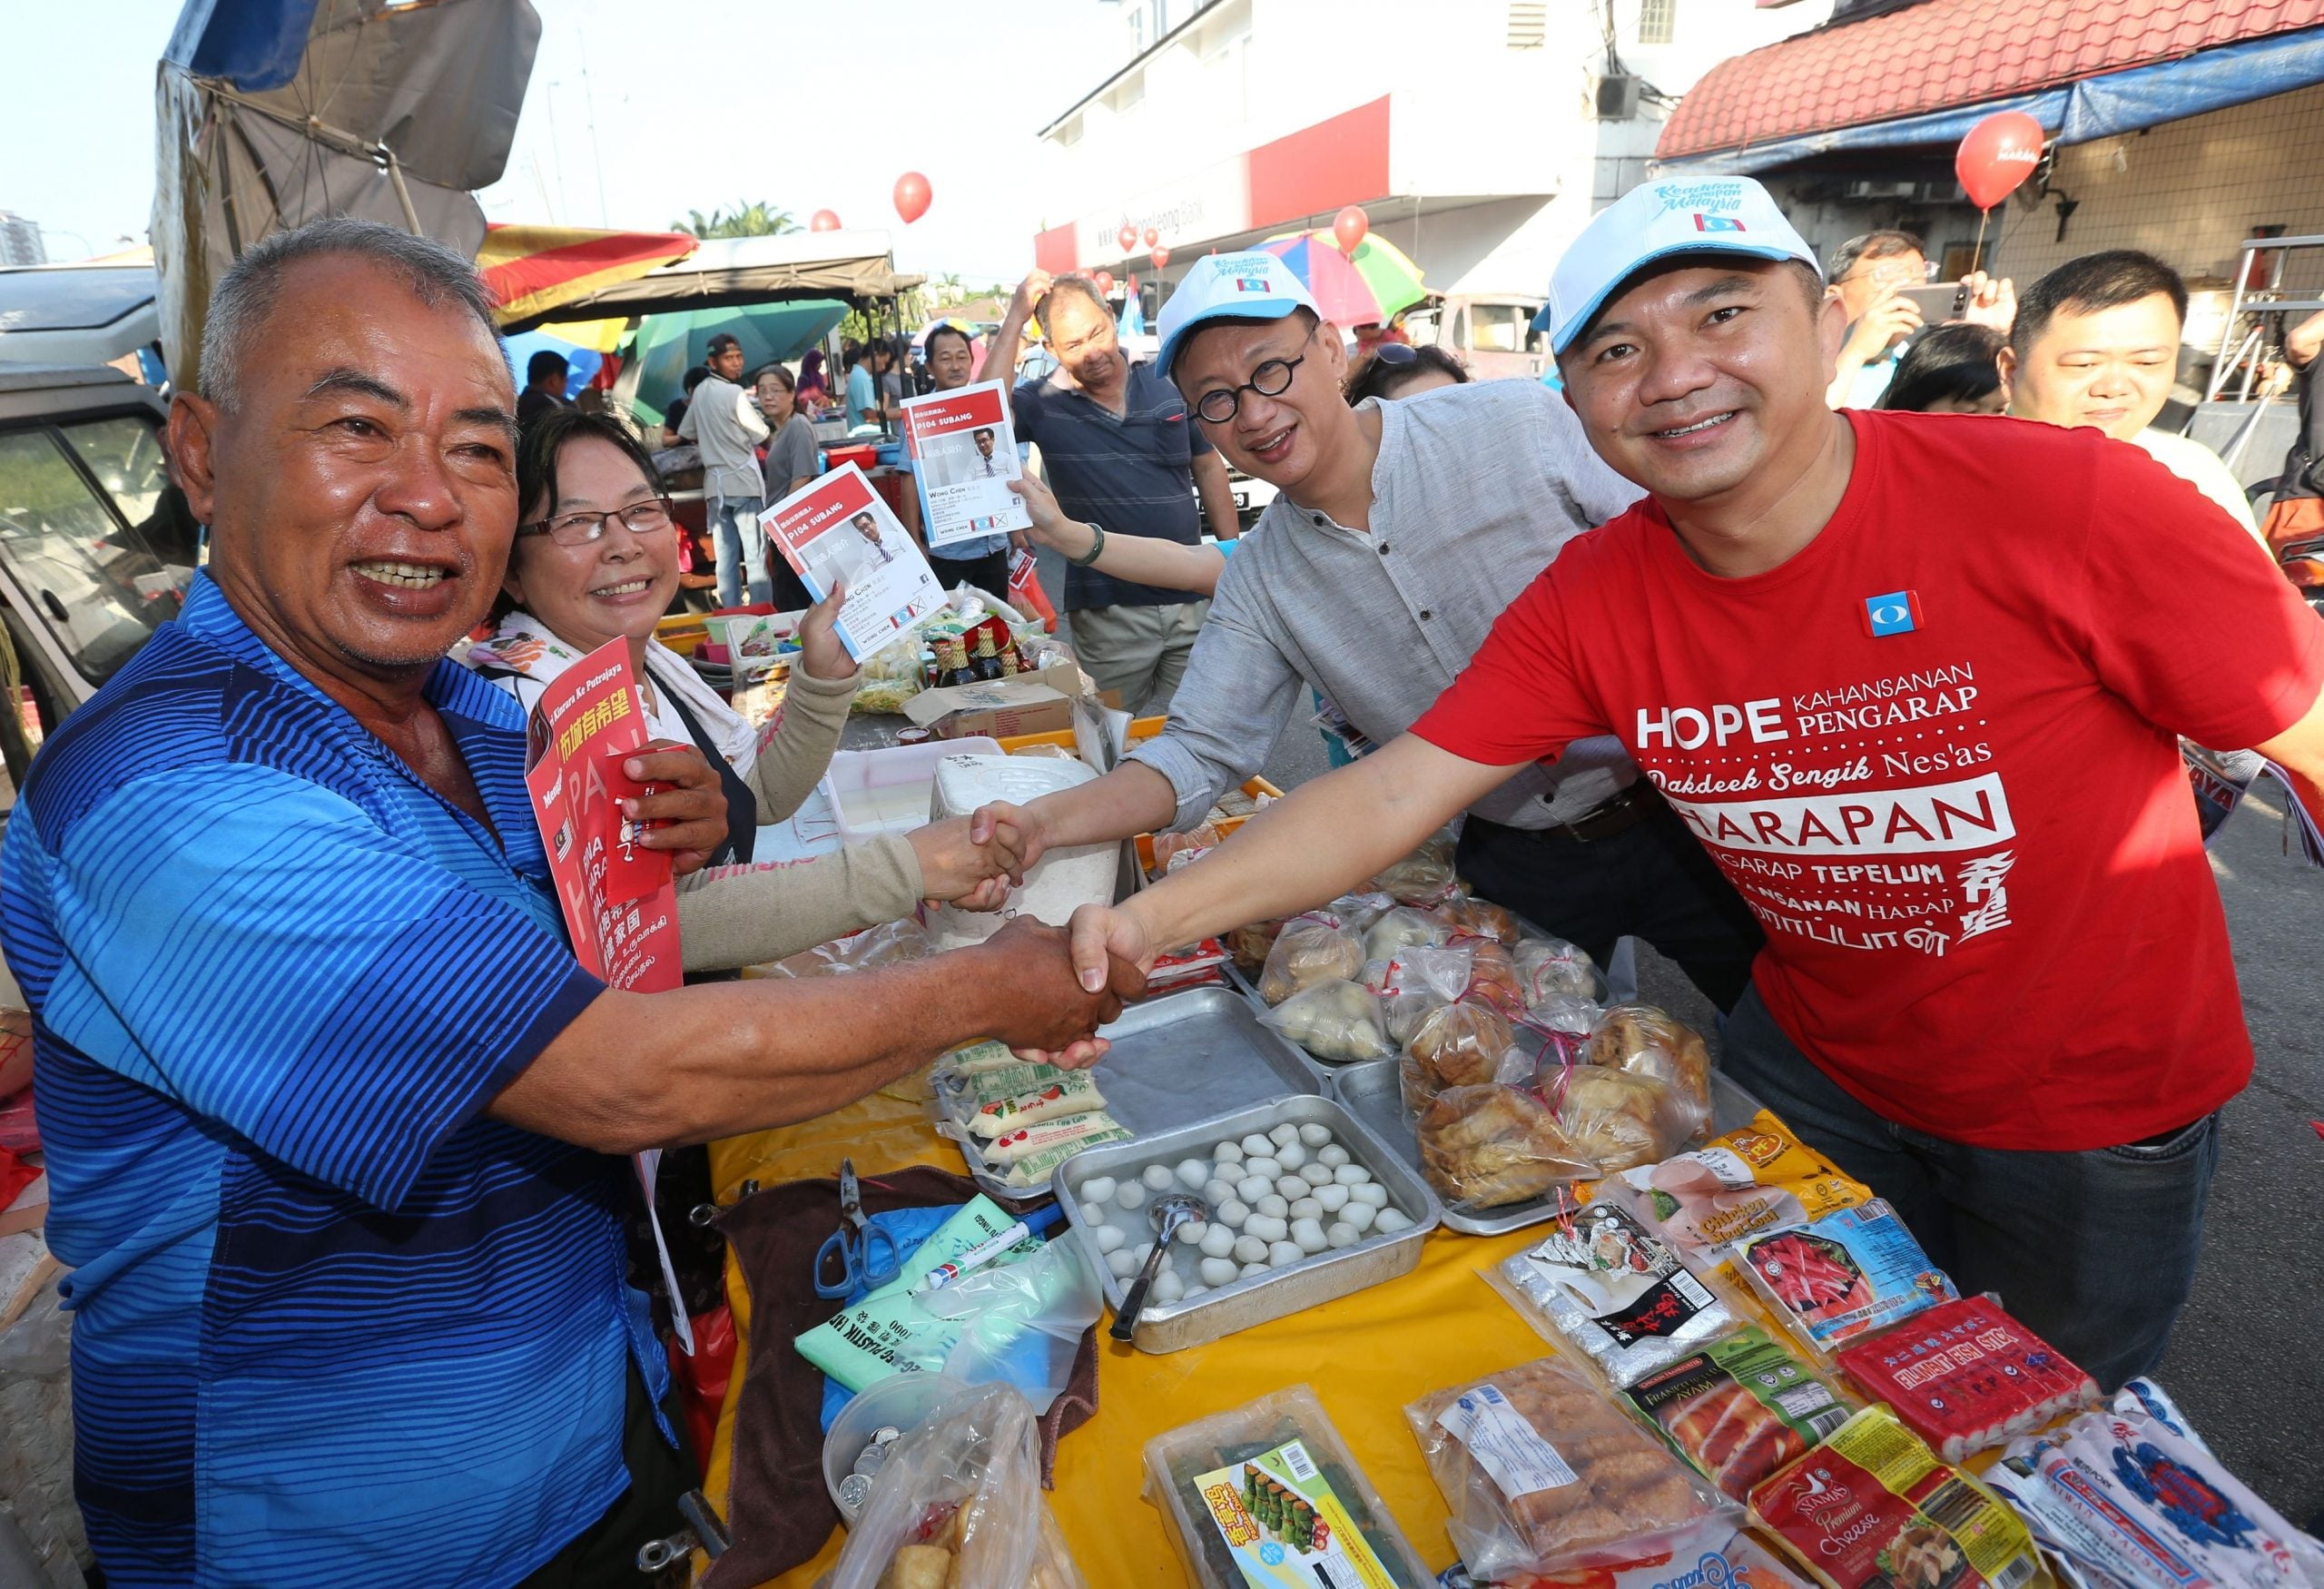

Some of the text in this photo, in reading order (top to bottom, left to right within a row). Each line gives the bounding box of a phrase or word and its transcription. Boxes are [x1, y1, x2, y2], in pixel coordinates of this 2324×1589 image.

[917, 412, 973, 430] P104 SUBANG
[787, 501, 843, 541] P104 SUBANG
[575, 686, 586, 700] Ke
[586, 663, 623, 692] Putrajaya
[1637, 662, 1974, 750] HOPE KAHANSANAN
[1797, 686, 1979, 737] PENGARAP
[1647, 741, 1993, 795] Dakdeek Sengik Nes'as
[1810, 864, 1945, 885] TEPELUM
[1866, 899, 1955, 920] HARAP
[973, 1213, 993, 1233] TINGGI
[1700, 1198, 1768, 1234] Chicken
[843, 1323, 887, 1356] PLASTIK
[889, 1319, 913, 1340] 1000
[1893, 1327, 2019, 1390] FILAMENT FISH STICK
[1677, 1380, 1715, 1401] AYAM
[2092, 1470, 2113, 1490] PORK
[1205, 1484, 1248, 1547] 香草鸡
[1224, 1481, 1260, 1542] Pandan Chicken
[1799, 1485, 1848, 1515] AYAMAS
[1816, 1501, 1863, 1535] Premium
[1820, 1514, 1880, 1555] Cheese
